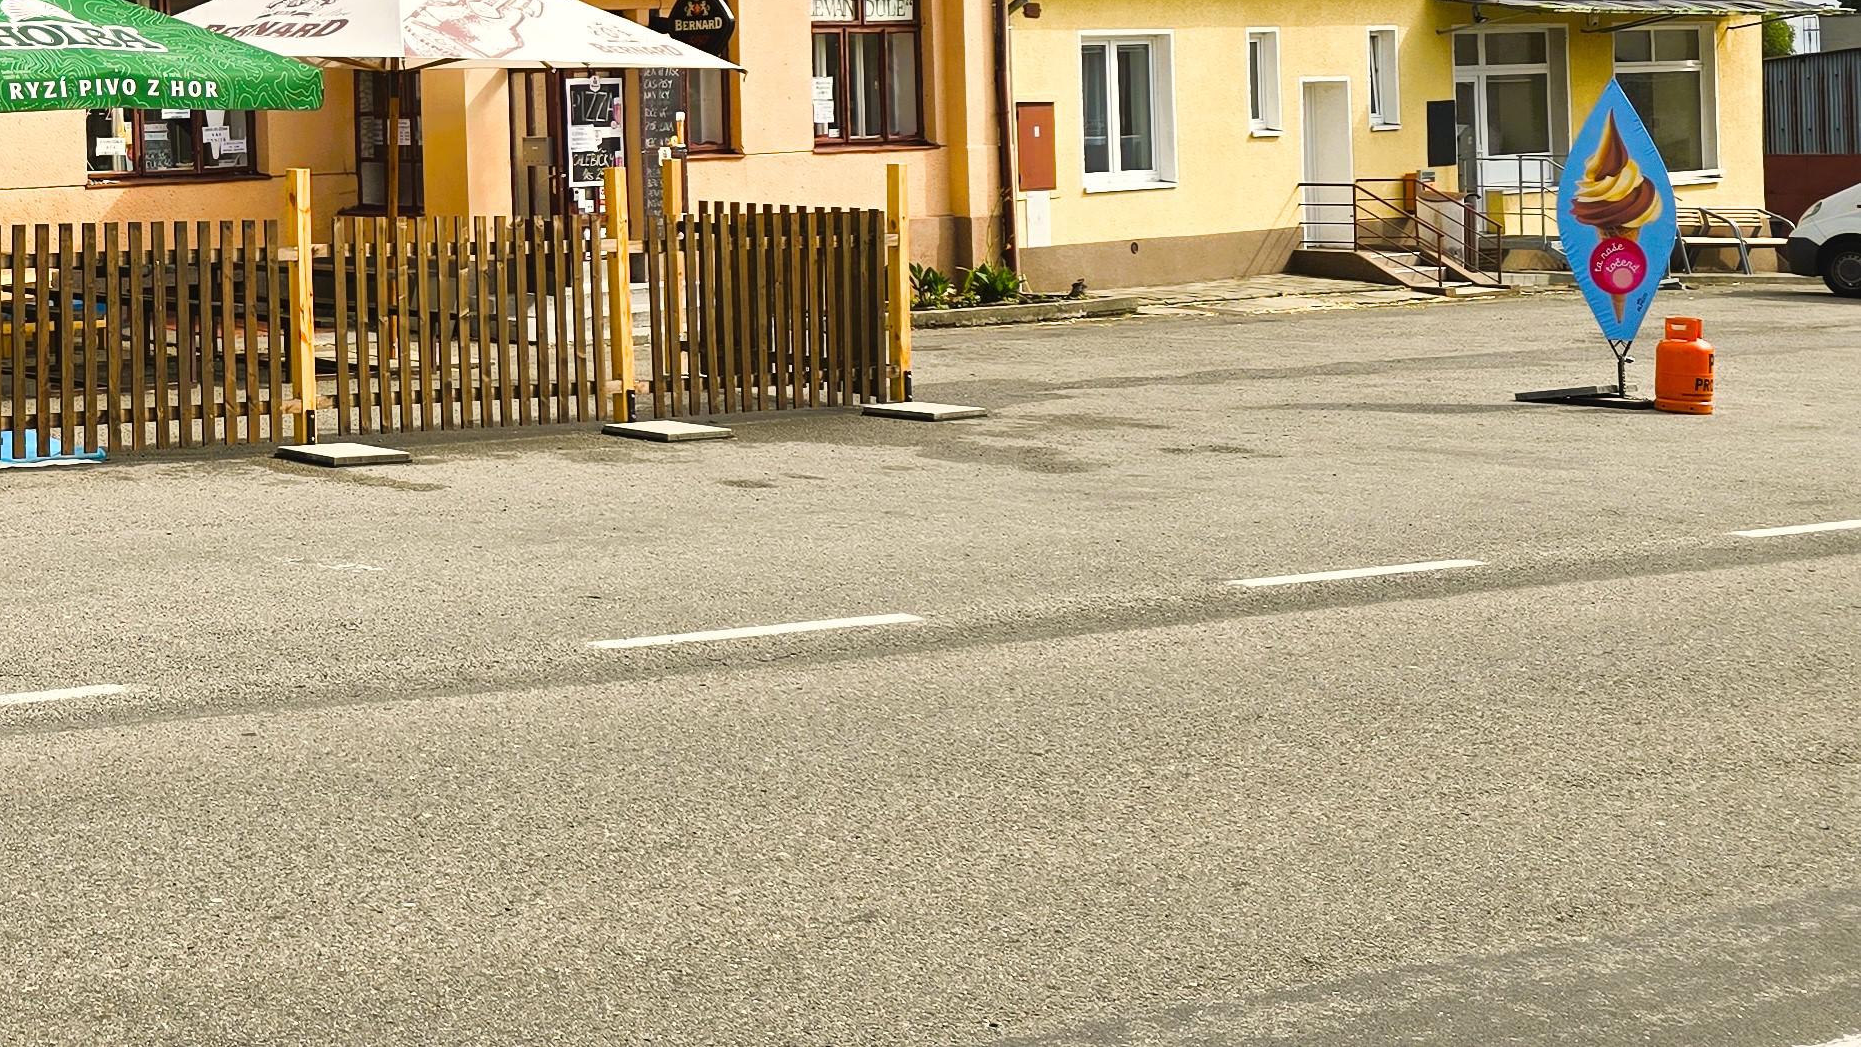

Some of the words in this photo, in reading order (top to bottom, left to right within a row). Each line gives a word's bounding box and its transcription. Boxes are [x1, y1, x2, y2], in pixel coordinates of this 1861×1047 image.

[674, 17, 723, 31] BERNARD
[588, 42, 684, 56] BERNARD
[9, 76, 68, 100] RYZÍ
[79, 78, 137, 97] PIVO
[147, 79, 160, 96] Z
[171, 80, 219, 98] HOR
[571, 91, 614, 122] PIZZA
